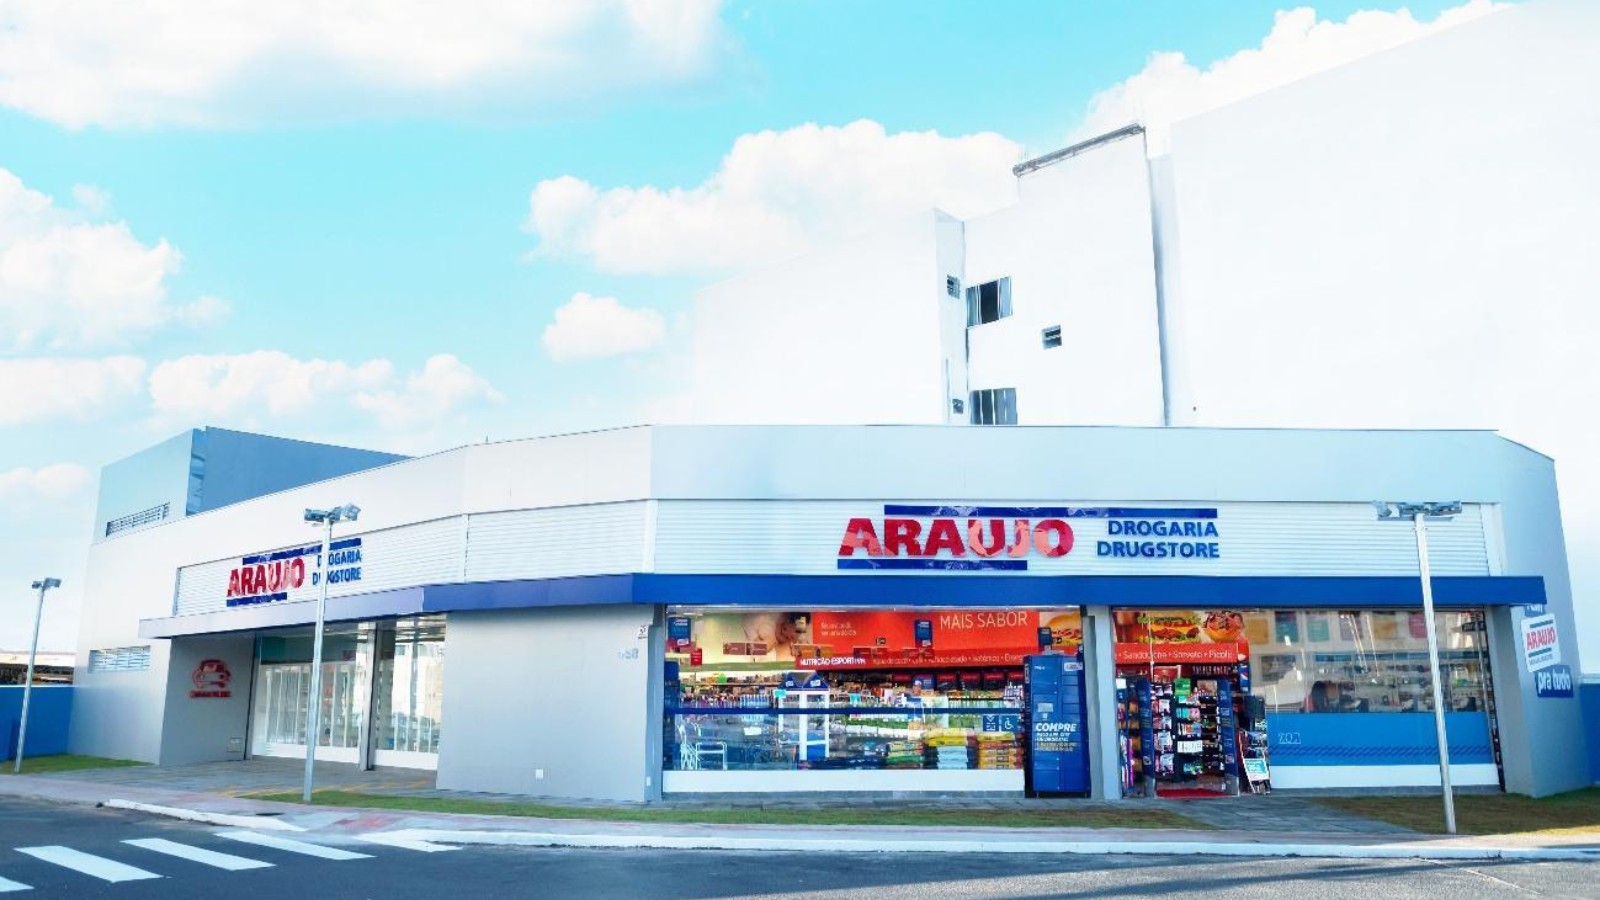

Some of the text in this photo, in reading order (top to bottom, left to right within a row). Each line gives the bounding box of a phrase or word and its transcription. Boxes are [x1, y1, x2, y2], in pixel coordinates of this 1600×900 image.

[838, 517, 1075, 558] ARAUJO
[1108, 519, 1219, 537] DROGARIA
[317, 549, 362, 568] DOGARIA
[1096, 540, 1220, 559] DRUGSTORE
[226, 557, 305, 598] ARAUJO
[312, 567, 362, 586] DGSTORE
[940, 613, 974, 630] MAIS
[977, 611, 1028, 628] SABOR
[1526, 627, 1556, 651] ARAUJO
[1537, 668, 1571, 694] pra tudo
[1035, 722, 1077, 732] COMPRE
